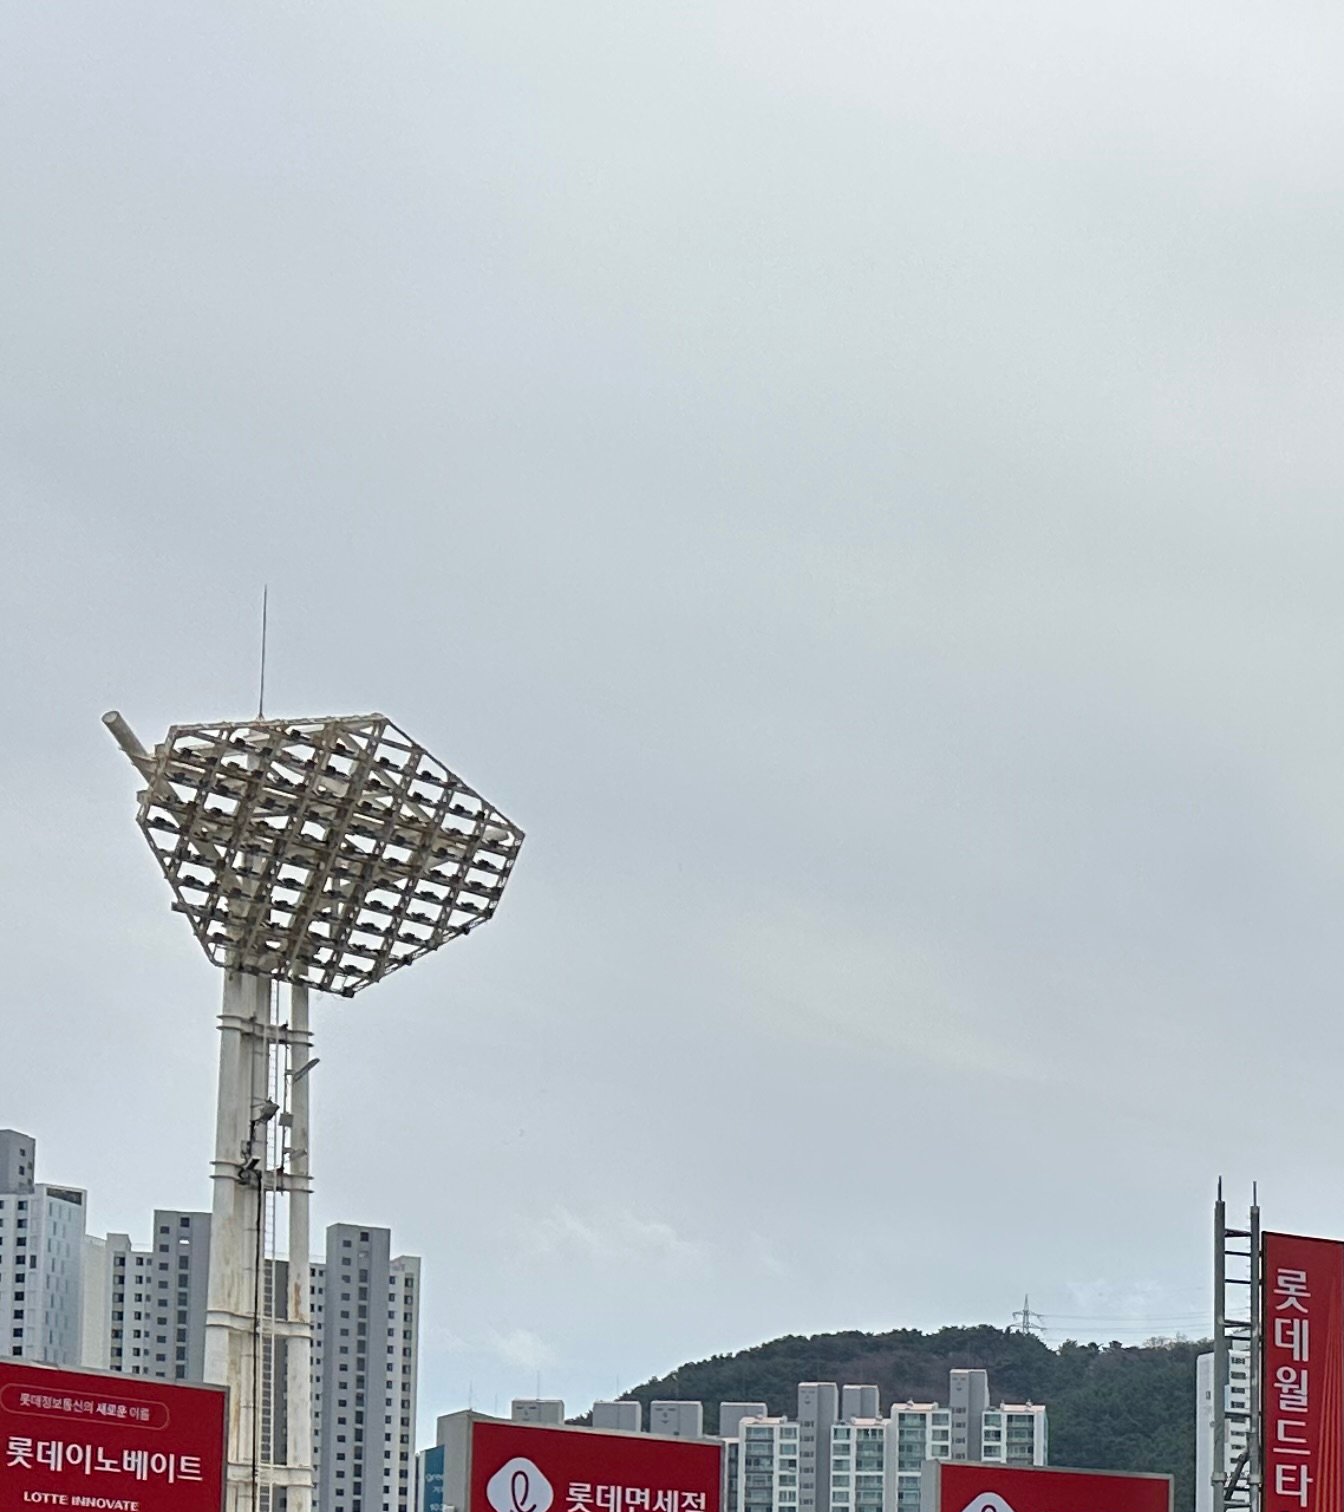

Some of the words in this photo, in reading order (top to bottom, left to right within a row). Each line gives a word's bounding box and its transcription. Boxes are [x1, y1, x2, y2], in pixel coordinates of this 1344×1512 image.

[20, 1393, 94, 1414] 롯데정보통신의
[96, 1403, 127, 1418] 새로운
[129, 1407, 150, 1421] 이름
[6, 1436, 203, 1484] 롯데이노베이트
[23, 1491, 68, 1505] LOTTE
[71, 1496, 140, 1512] INNOVATE
